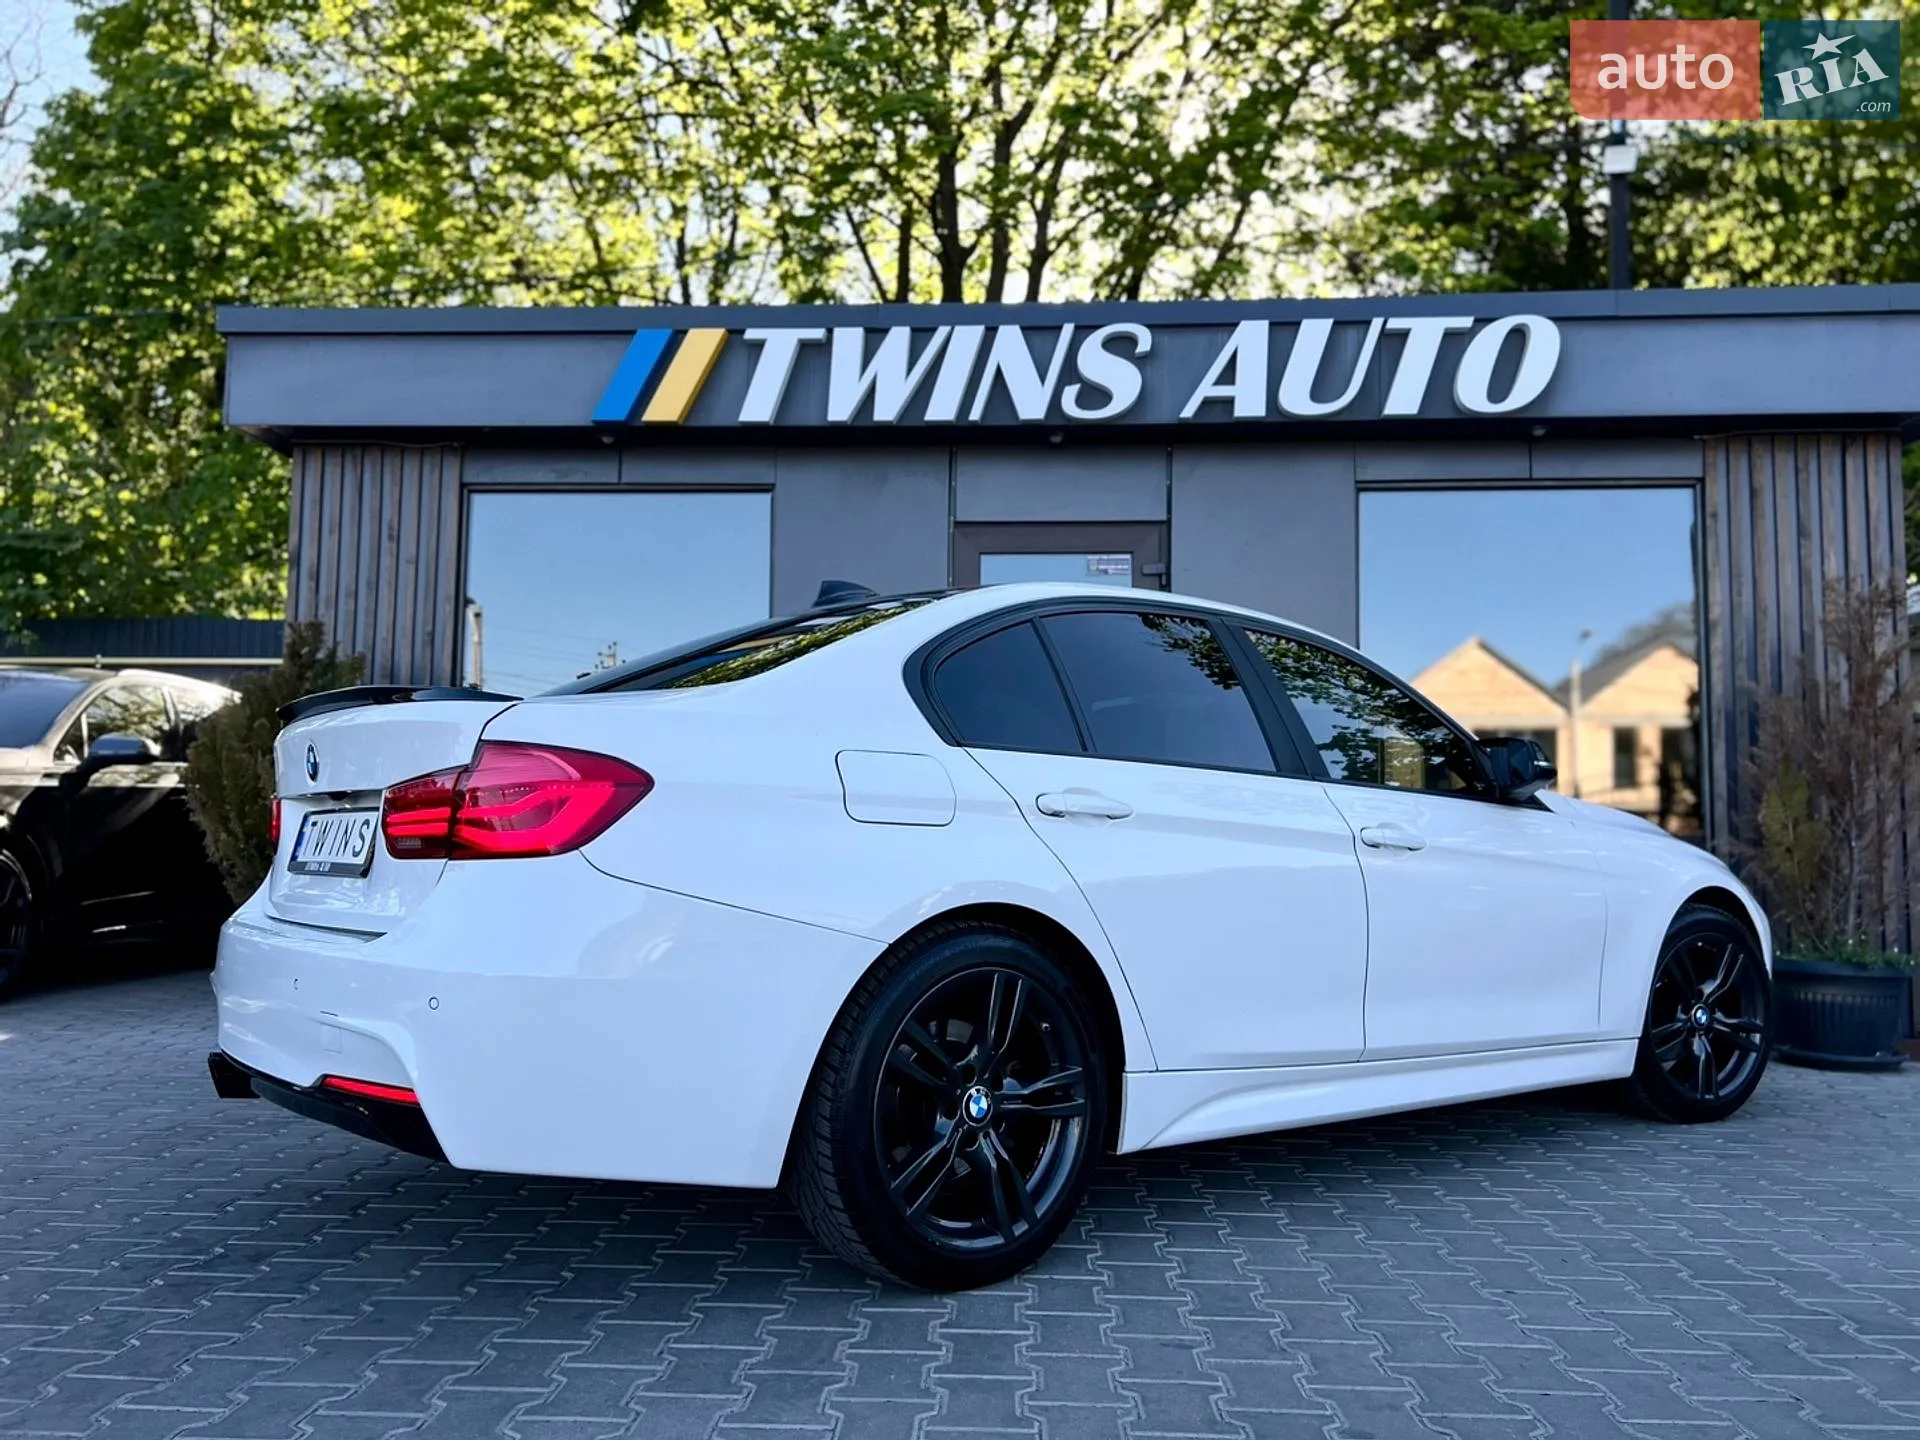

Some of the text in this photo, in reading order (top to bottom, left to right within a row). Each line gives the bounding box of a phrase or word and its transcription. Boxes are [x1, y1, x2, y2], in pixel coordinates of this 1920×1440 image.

[738, 314, 1561, 425] TWINS AUTO
[303, 818, 370, 858] TWINS
